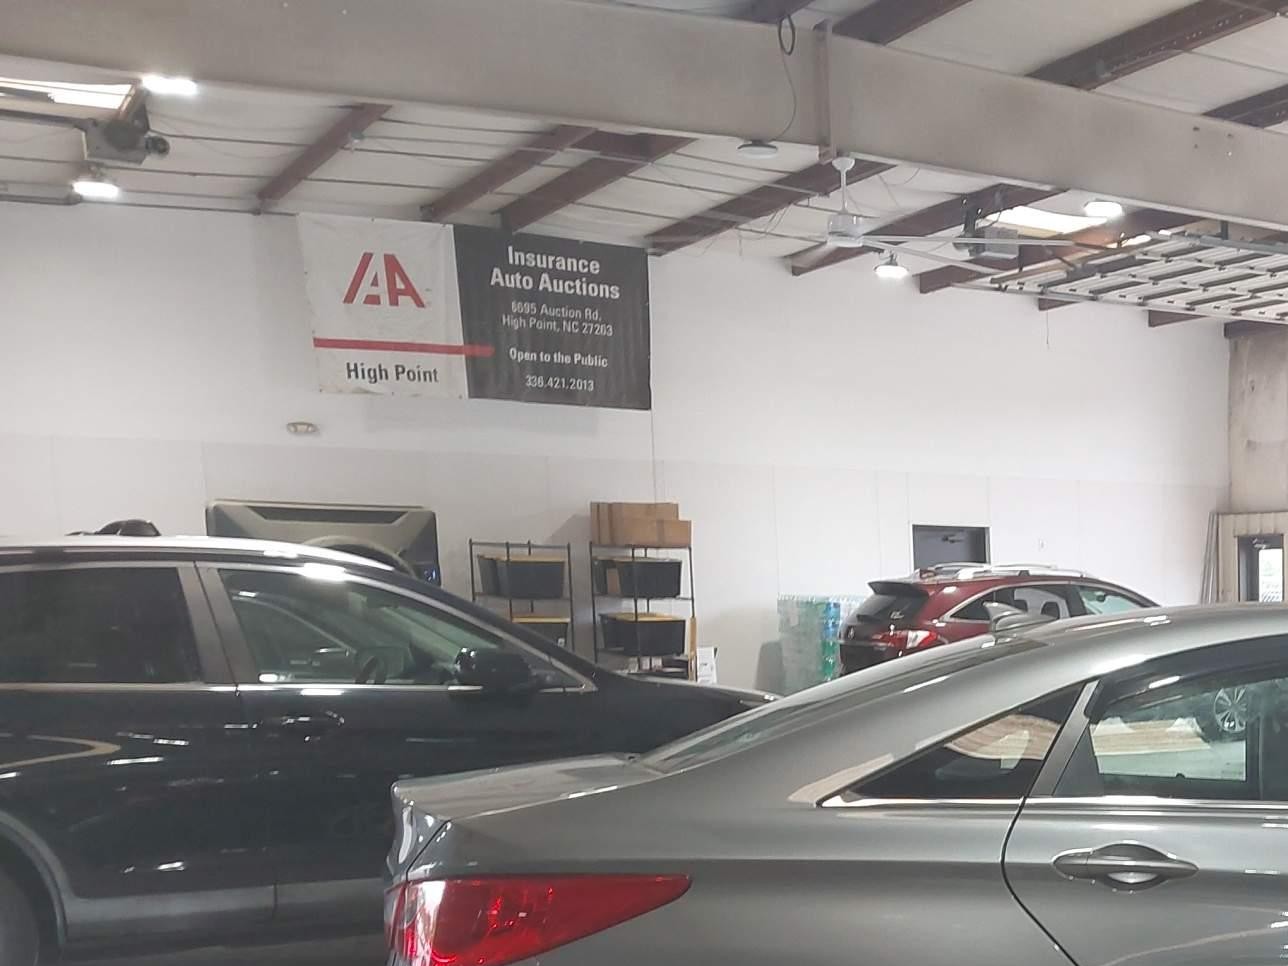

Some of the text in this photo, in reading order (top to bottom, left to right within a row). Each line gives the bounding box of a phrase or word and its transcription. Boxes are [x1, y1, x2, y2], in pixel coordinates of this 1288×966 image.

[508, 246, 600, 274] Insurance
[490, 268, 620, 299] Auto Auctions
[540, 303, 582, 318] Auction
[502, 314, 526, 330] High
[563, 320, 579, 334] NC
[509, 348, 608, 367] Open to the Public
[346, 362, 439, 384] High Point
